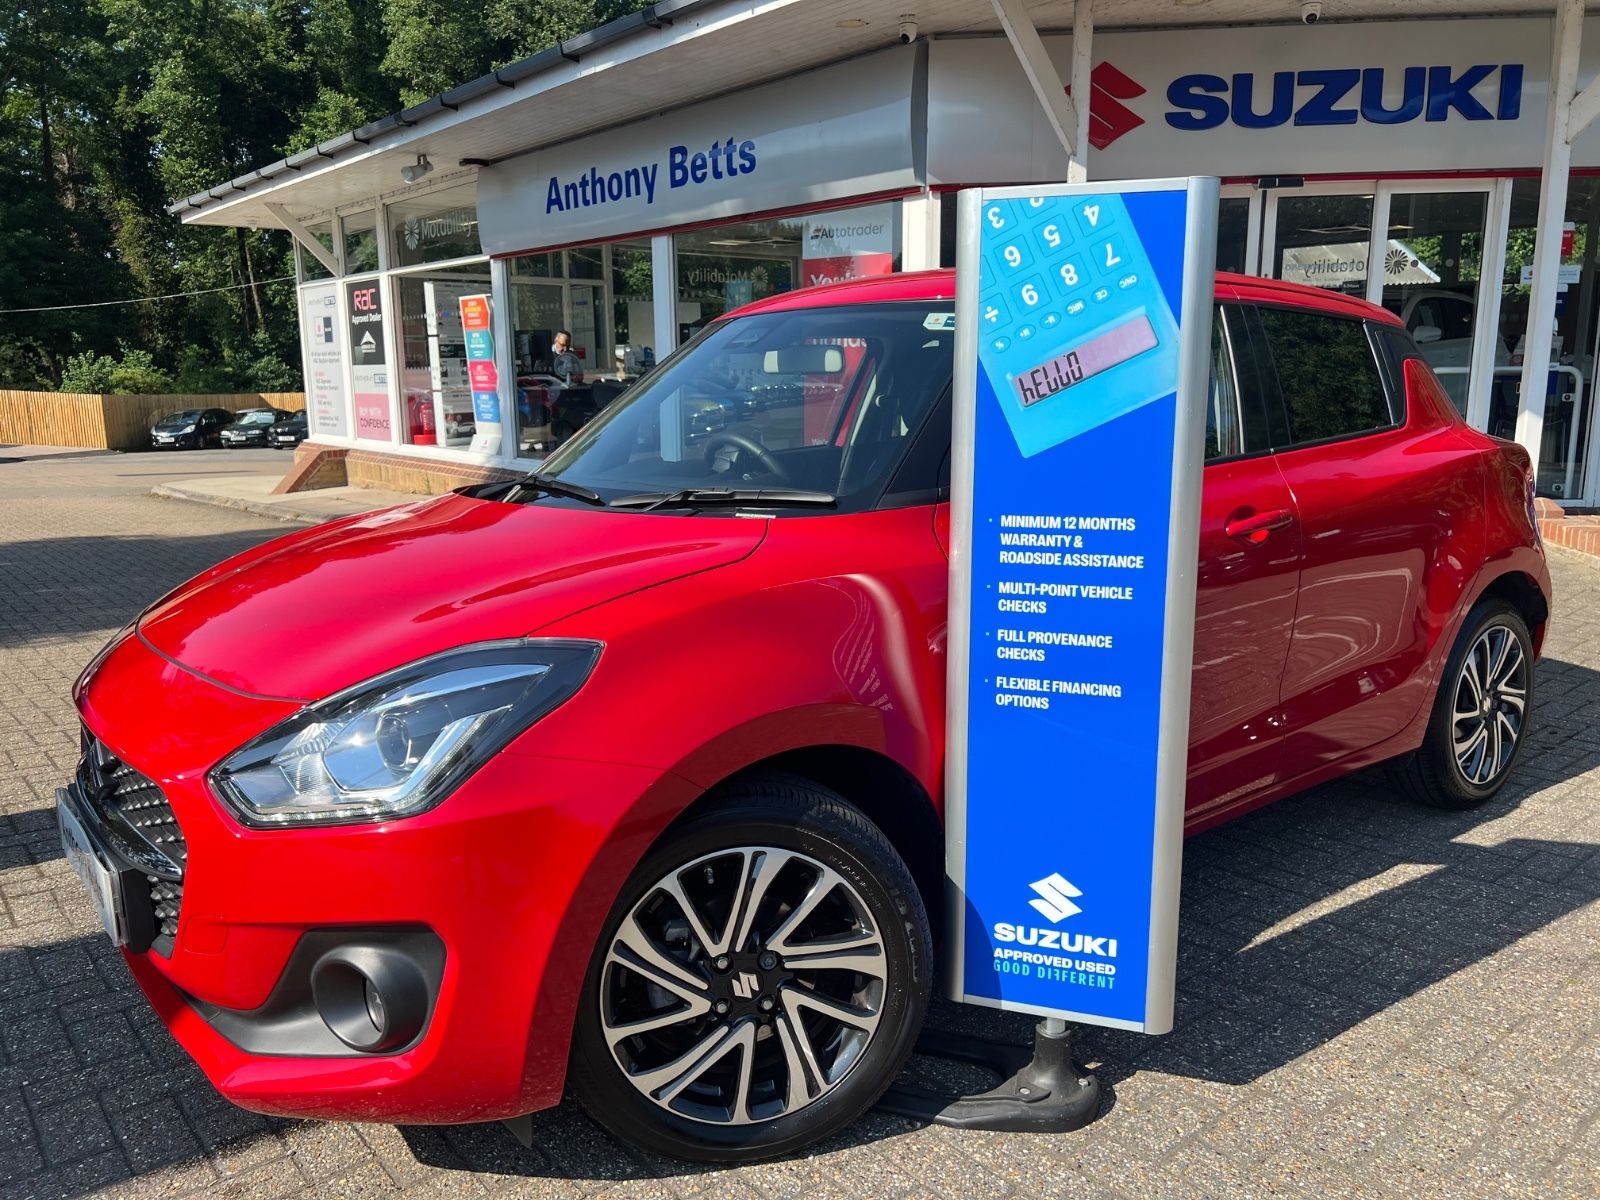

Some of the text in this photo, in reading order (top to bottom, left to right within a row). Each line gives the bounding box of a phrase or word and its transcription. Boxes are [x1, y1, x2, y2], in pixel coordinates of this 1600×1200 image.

[1164, 63, 1524, 130] SUZUKI
[546, 137, 757, 214] Anthony Betts
[421, 208, 472, 240] Motability
[821, 224, 884, 239] Autotrader
[1060, 264, 1078, 286] 8
[1000, 515, 1136, 531] MINIMUM 12 MONTHS
[1000, 533, 1083, 548] WARRANTY &
[999, 551, 1144, 569] ROADSIDE ASSISTANCE
[998, 582, 1133, 600] MULTI-POINT VEHICLE
[998, 599, 1047, 614] CHECKS
[997, 629, 1113, 648] FULL PROVENANCE
[997, 647, 1046, 662] CHECKS
[996, 676, 1122, 698] FLEXIBLE FINANCING
[995, 694, 1050, 710] OPTIONS
[993, 922, 1118, 958] SUZUKI
[993, 947, 1116, 976] APPROVED USED
[993, 959, 1116, 990] GOOD DIFFERENT
